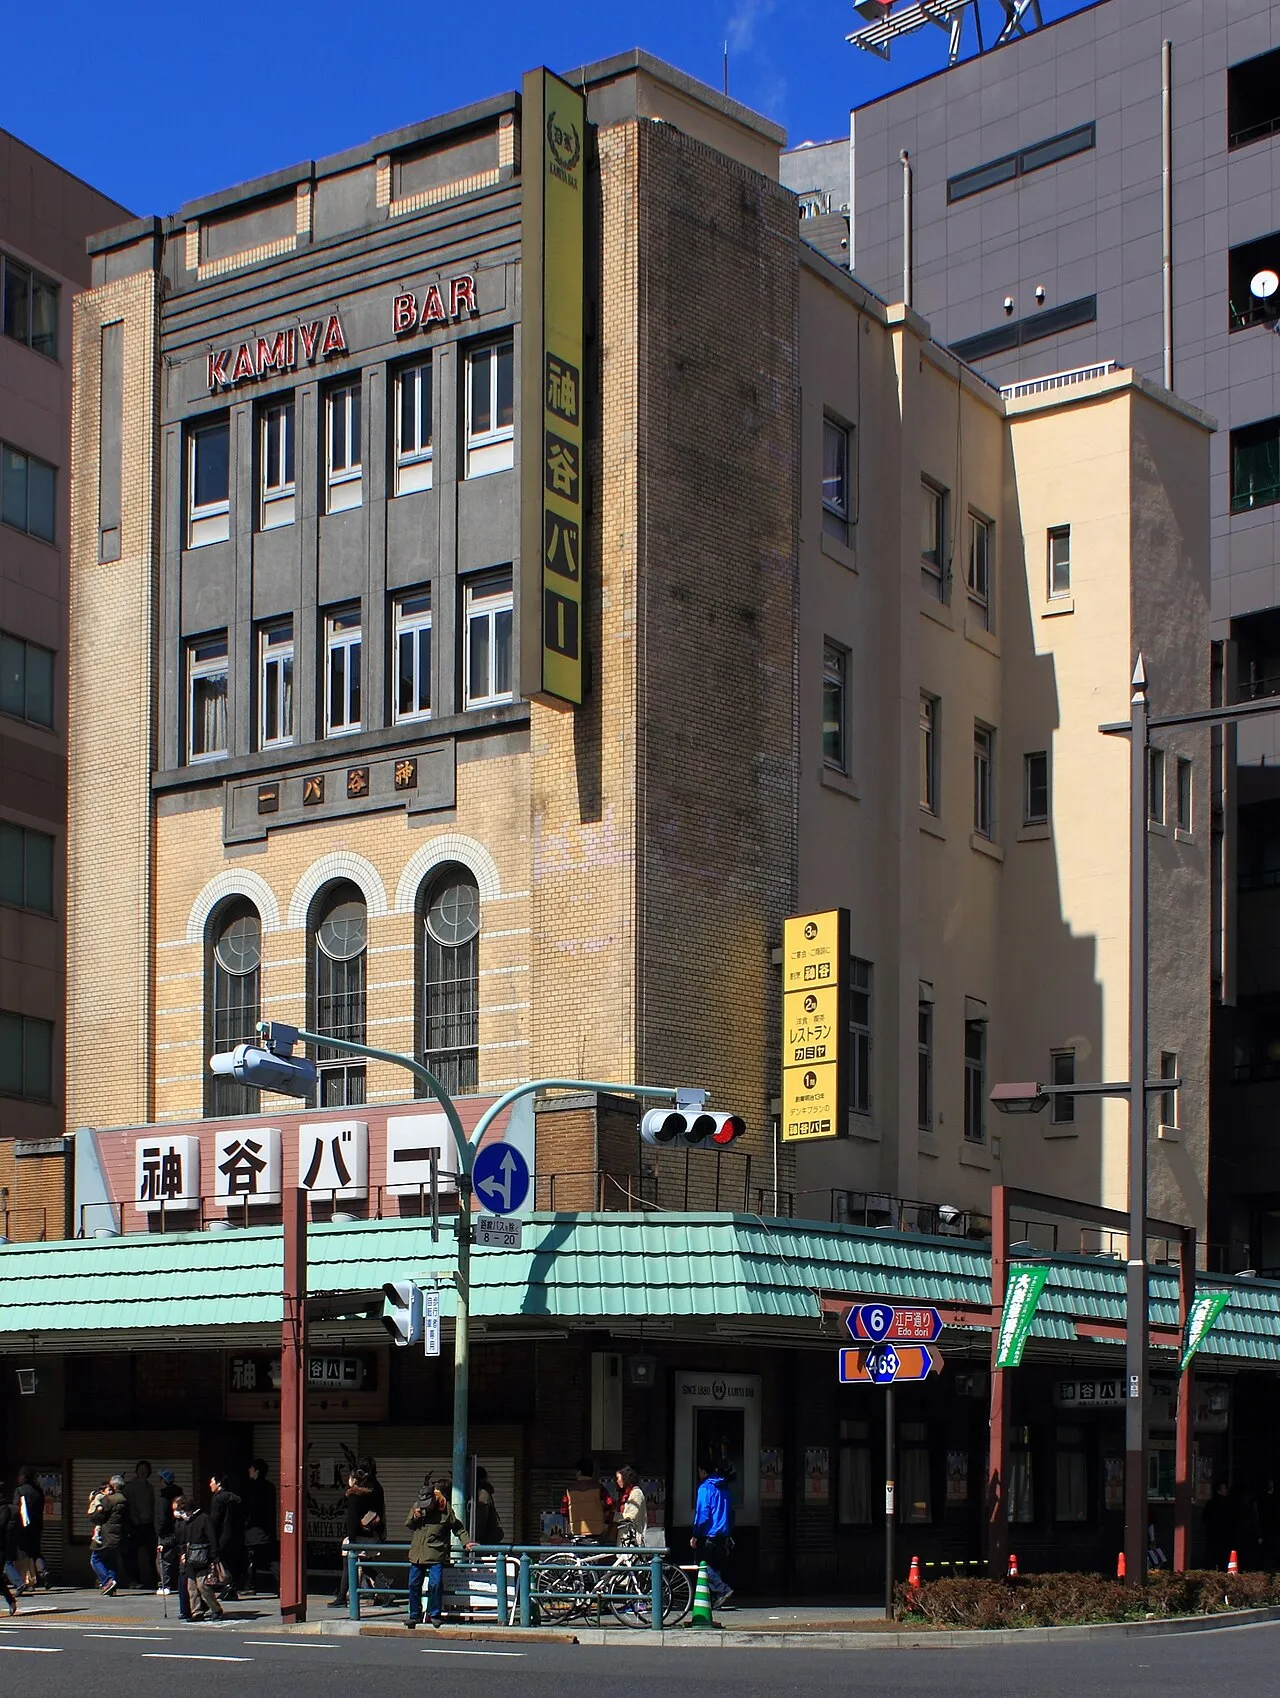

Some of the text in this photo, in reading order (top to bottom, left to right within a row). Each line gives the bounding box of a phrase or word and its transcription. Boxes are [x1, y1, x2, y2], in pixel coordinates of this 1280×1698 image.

[206, 273, 477, 390] KAMIYA BAR
[547, 361, 578, 649] 神谷バー
[790, 1025, 831, 1044] レストラン
[795, 1046, 825, 1060] カミヤ
[789, 1121, 830, 1136] 神谷バー
[141, 1130, 441, 1200] 神谷バー
[870, 1309, 885, 1332] 6
[895, 1311, 931, 1328] 江戸通り
[897, 1328, 929, 1337] Edo dori
[868, 1353, 897, 1375] 463
[307, 1521, 333, 1538] AMIYA
